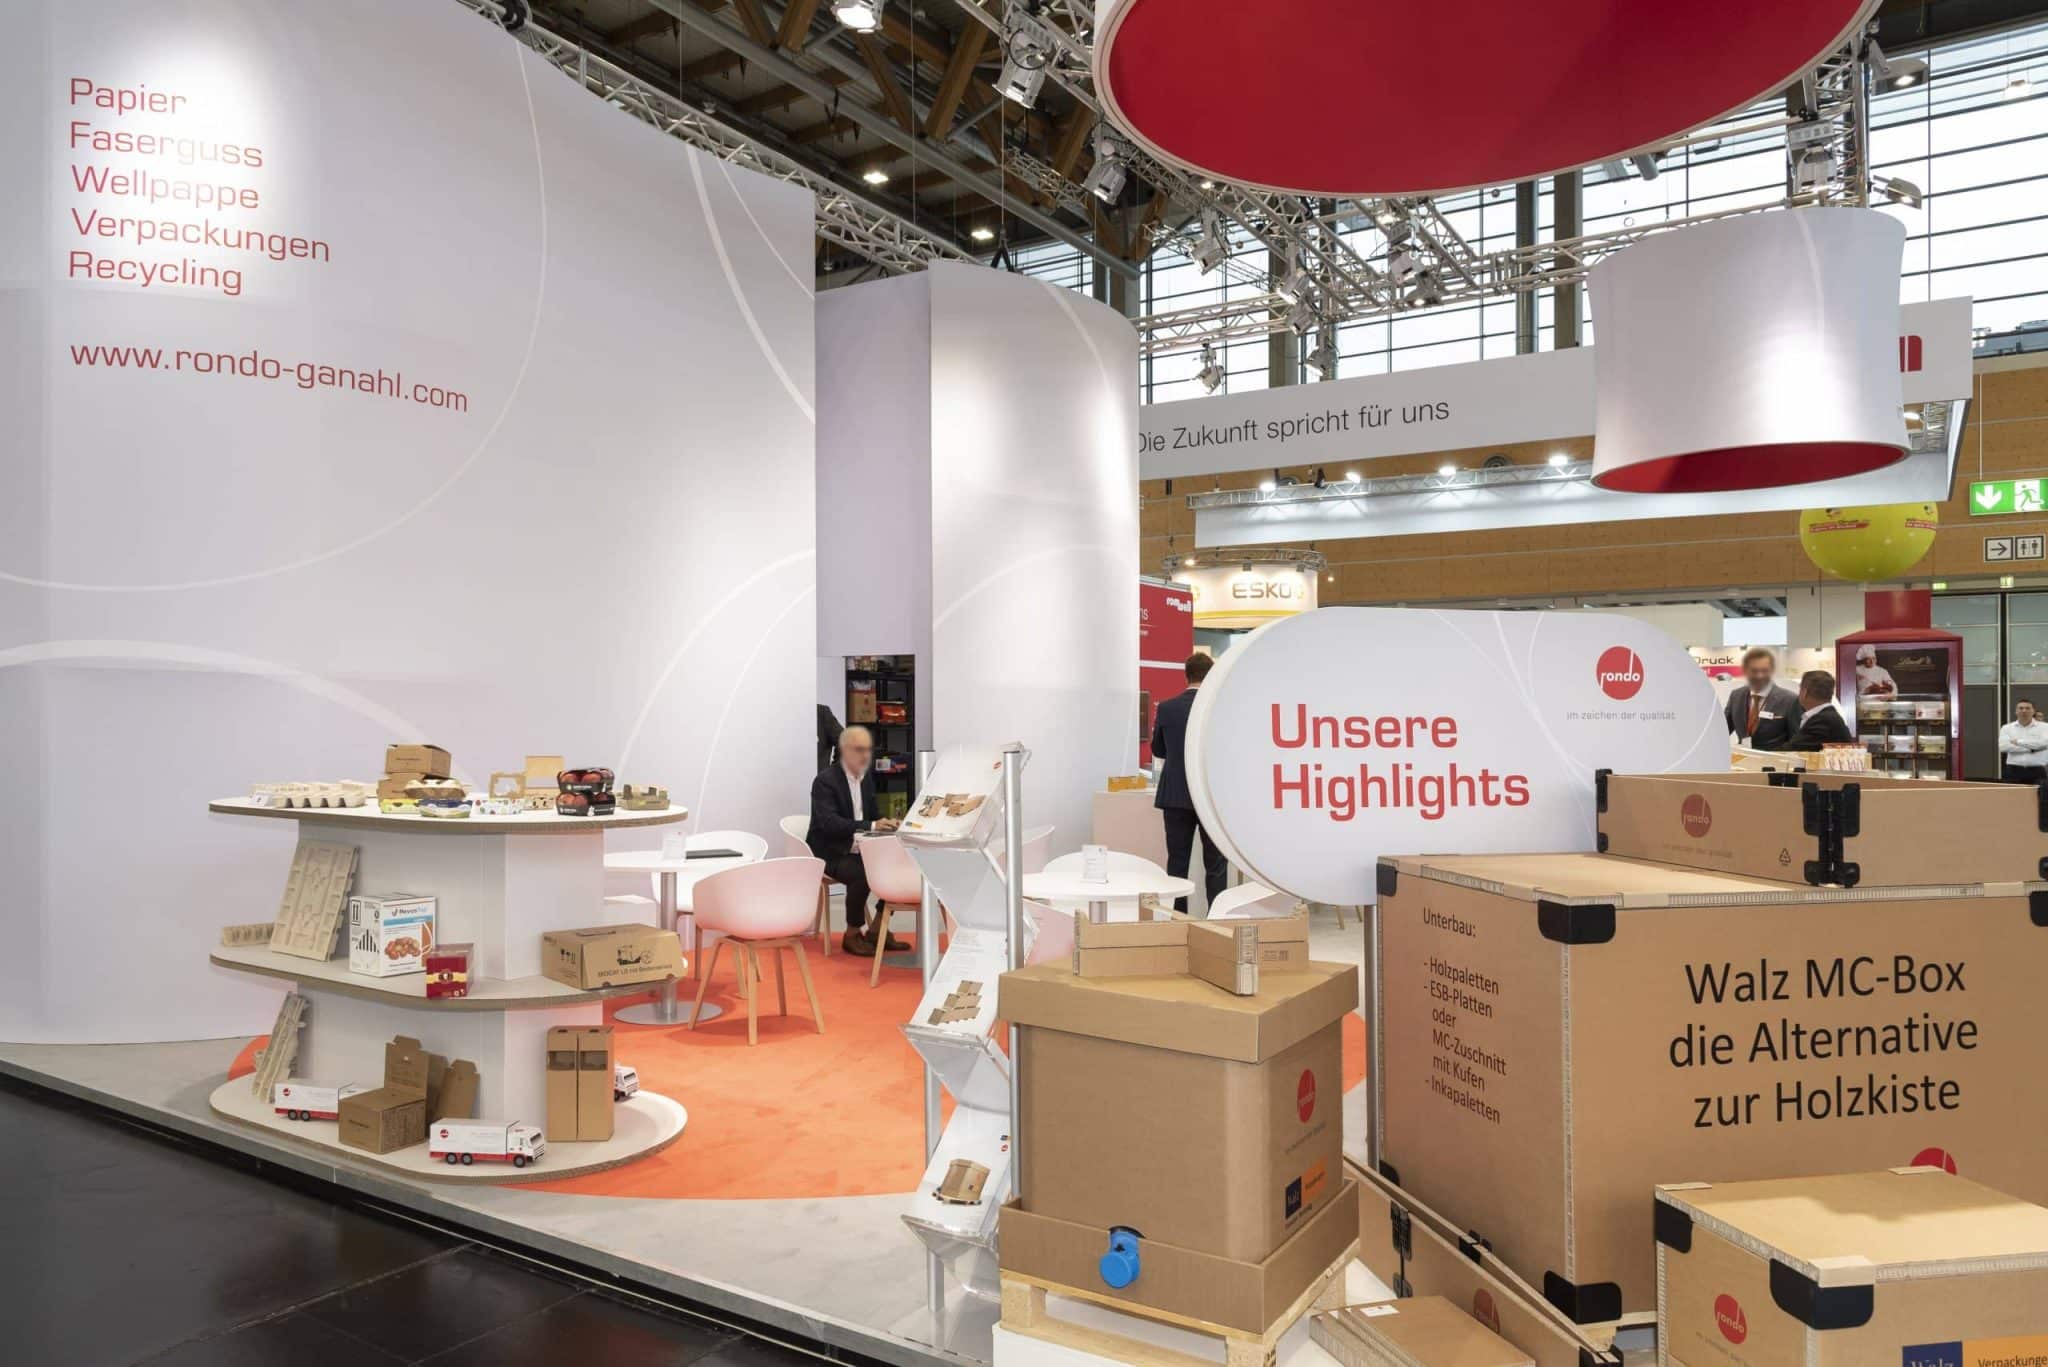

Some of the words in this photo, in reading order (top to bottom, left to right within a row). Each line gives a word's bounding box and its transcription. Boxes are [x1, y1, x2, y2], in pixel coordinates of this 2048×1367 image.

[70, 77, 187, 116] Papier
[70, 121, 264, 168] Faserguss
[71, 164, 260, 211] Wellpappe
[71, 207, 330, 263] Verpackungen
[68, 250, 243, 296] Recycling
[70, 344, 469, 413] www.rondo-ganahl.com
[1172, 419, 1259, 450] Zukunft
[1266, 409, 1350, 442] spricht
[1358, 405, 1393, 429] für
[1401, 401, 1450, 424] uns
[1599, 648, 1641, 690] rondo
[1271, 703, 1458, 749] Unsere
[1272, 763, 1531, 822] Highlights
[1423, 906, 1476, 938] Unterbau:
[1684, 958, 1790, 1004] Walz
[1805, 954, 1966, 999] MC-Box
[1432, 1007, 1456, 1028] oder
[1669, 1023, 1734, 1068] die
[1748, 1012, 1978, 1063] Alternative
[1432, 1028, 1507, 1076] MC-Zuschnitt
[1432, 1055, 1451, 1075] mit
[1453, 1061, 1485, 1092] Kufen
[1693, 1093, 1761, 1128] zur
[1775, 1073, 1961, 1122] Holzkiste
